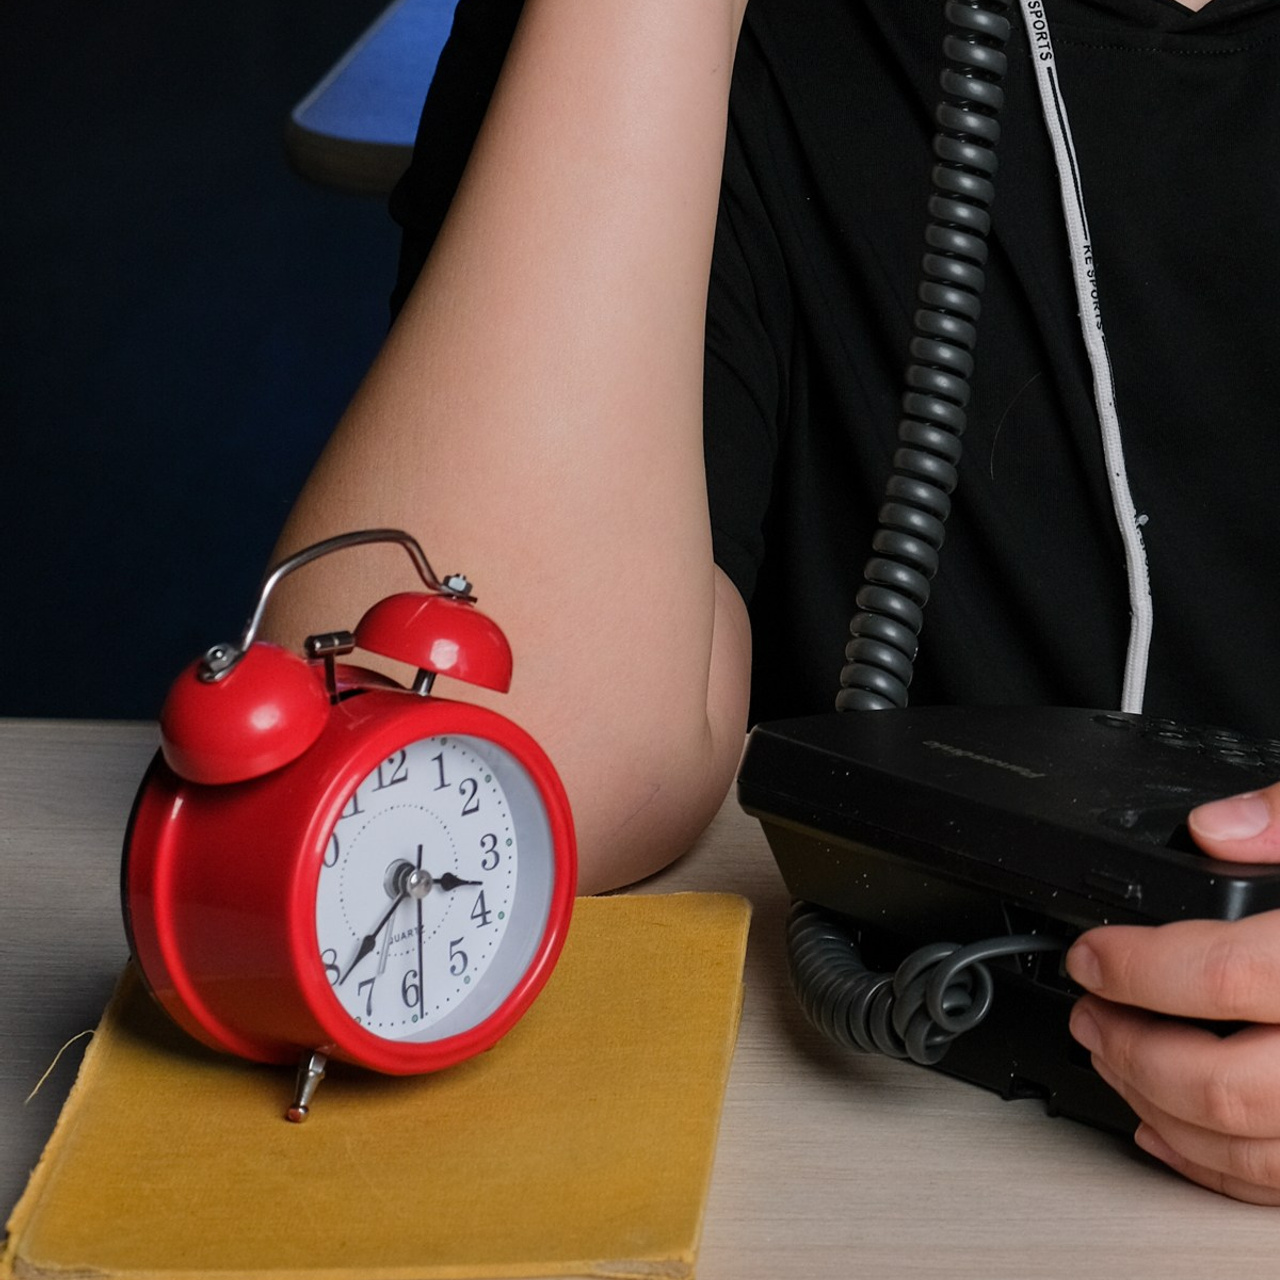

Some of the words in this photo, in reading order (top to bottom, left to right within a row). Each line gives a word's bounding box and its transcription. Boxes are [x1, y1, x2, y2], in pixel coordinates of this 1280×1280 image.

[1028, 0, 1052, 61] SPORTS
[371, 749, 409, 793] 12
[431, 751, 452, 791] 1
[459, 777, 480, 816] 2
[479, 832, 500, 871] 3
[470, 890, 492, 929] 4
[321, 948, 341, 987] 8
[449, 936, 468, 976] 5
[358, 976, 376, 1017] 7
[401, 969, 420, 1008] 6
